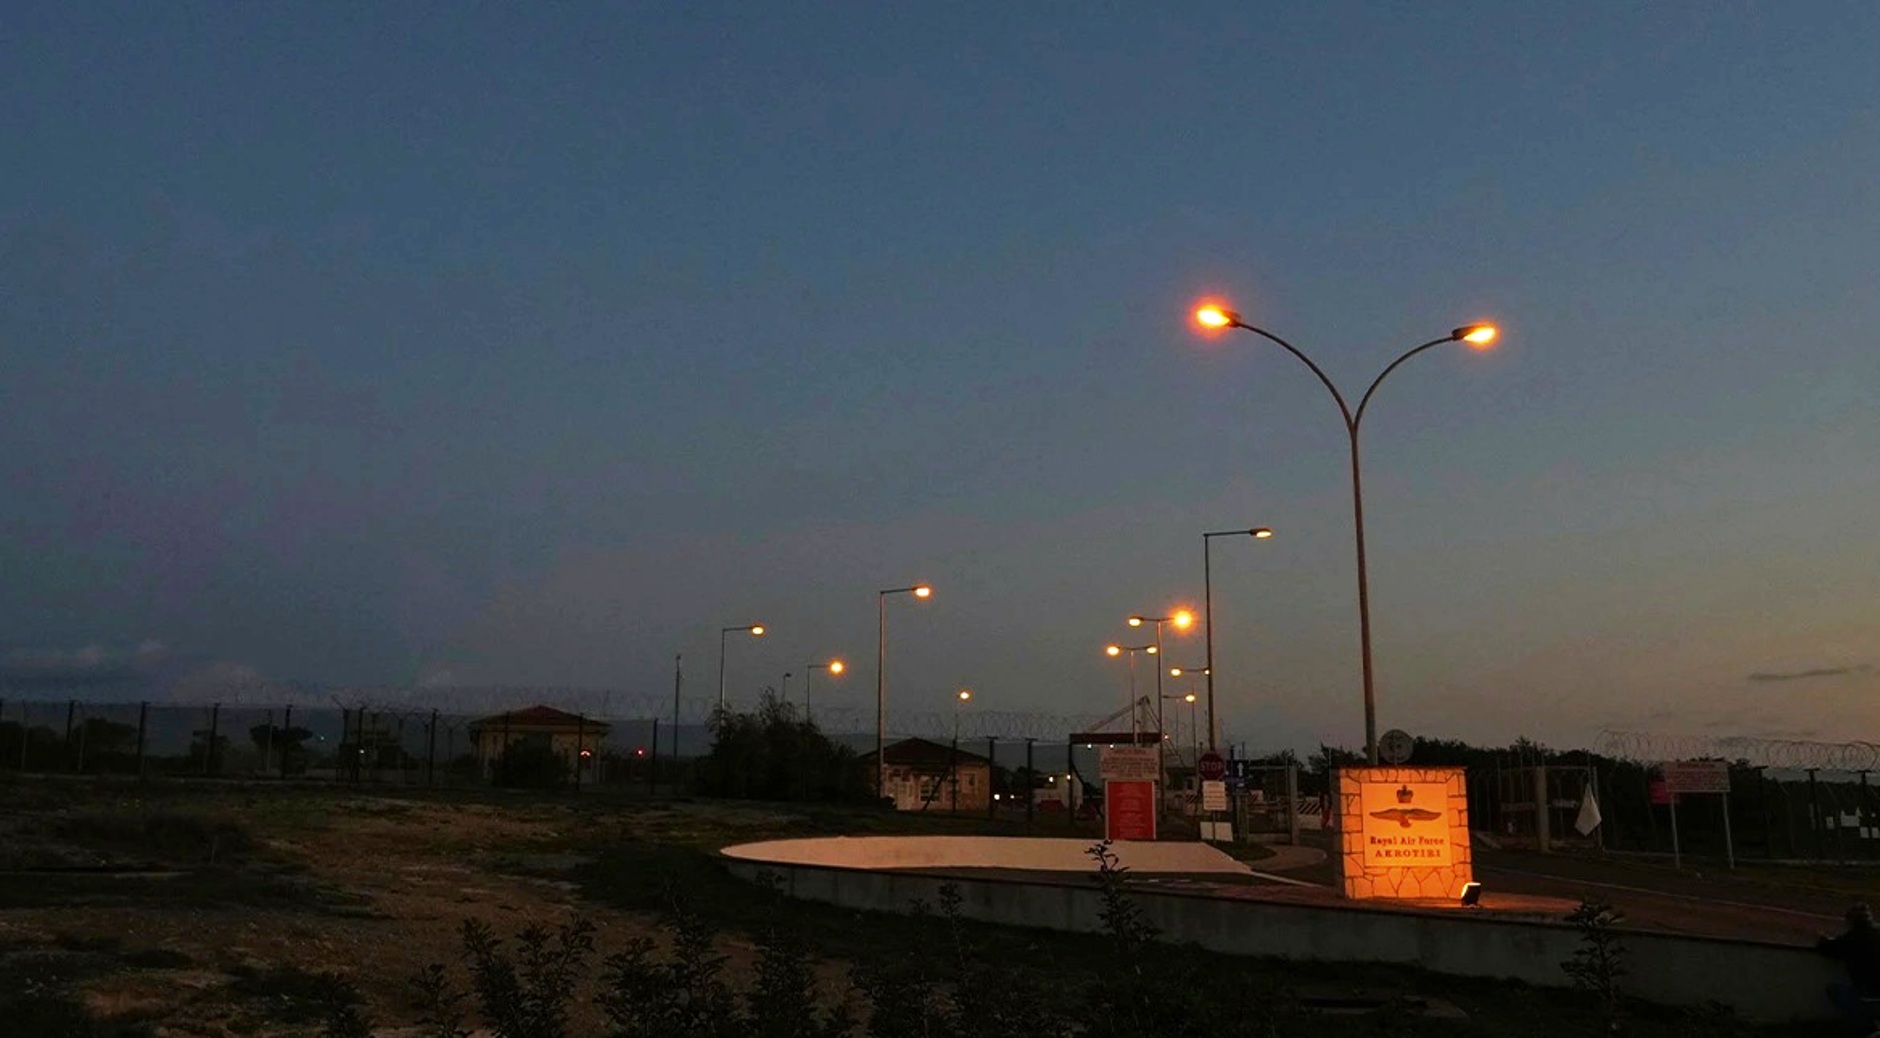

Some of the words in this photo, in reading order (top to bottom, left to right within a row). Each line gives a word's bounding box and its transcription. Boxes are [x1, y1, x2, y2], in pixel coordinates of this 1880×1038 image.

[1200, 761, 1223, 771] STOP
[1370, 836, 1397, 846] Royal
[1401, 836, 1416, 845] Air
[1418, 836, 1444, 845] Force
[1375, 849, 1441, 858] AKROTIRI
